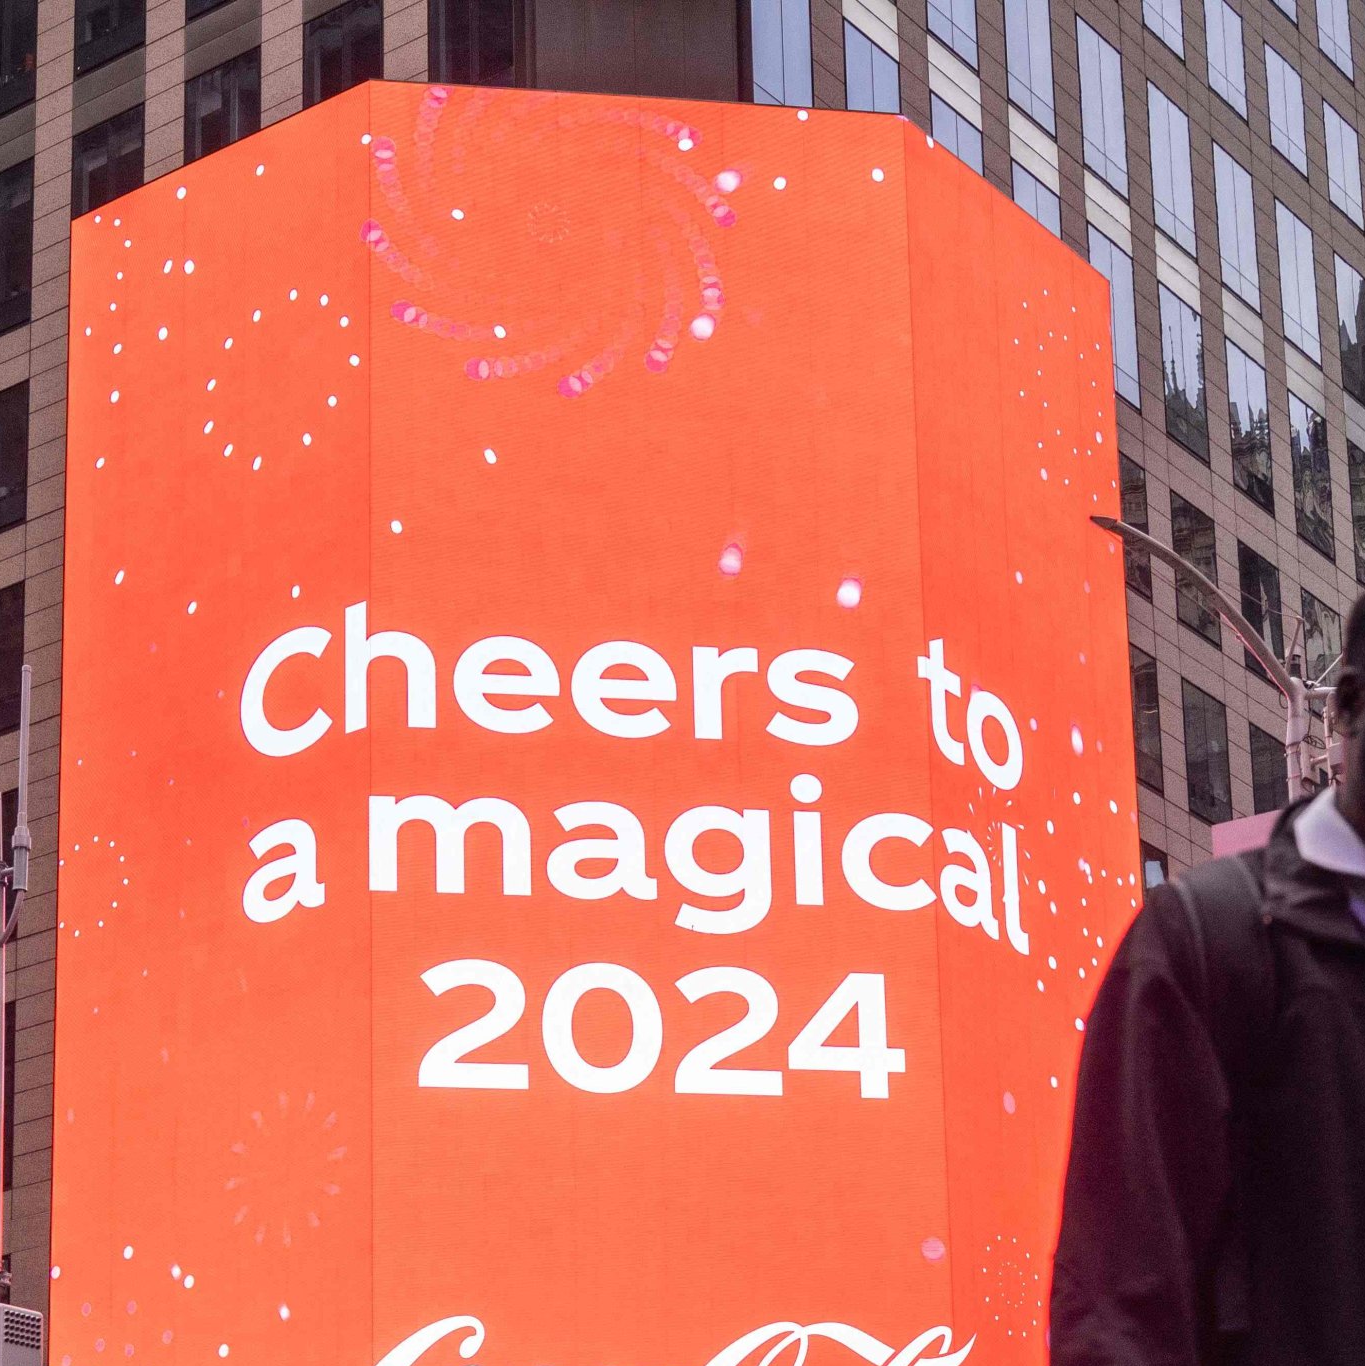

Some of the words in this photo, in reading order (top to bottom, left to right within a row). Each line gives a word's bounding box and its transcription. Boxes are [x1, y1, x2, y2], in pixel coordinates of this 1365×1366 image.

[239, 600, 859, 757] Cheers
[916, 637, 1025, 791] to
[241, 818, 326, 923] a
[368, 772, 1030, 956] magical
[417, 958, 906, 1099] 2024
